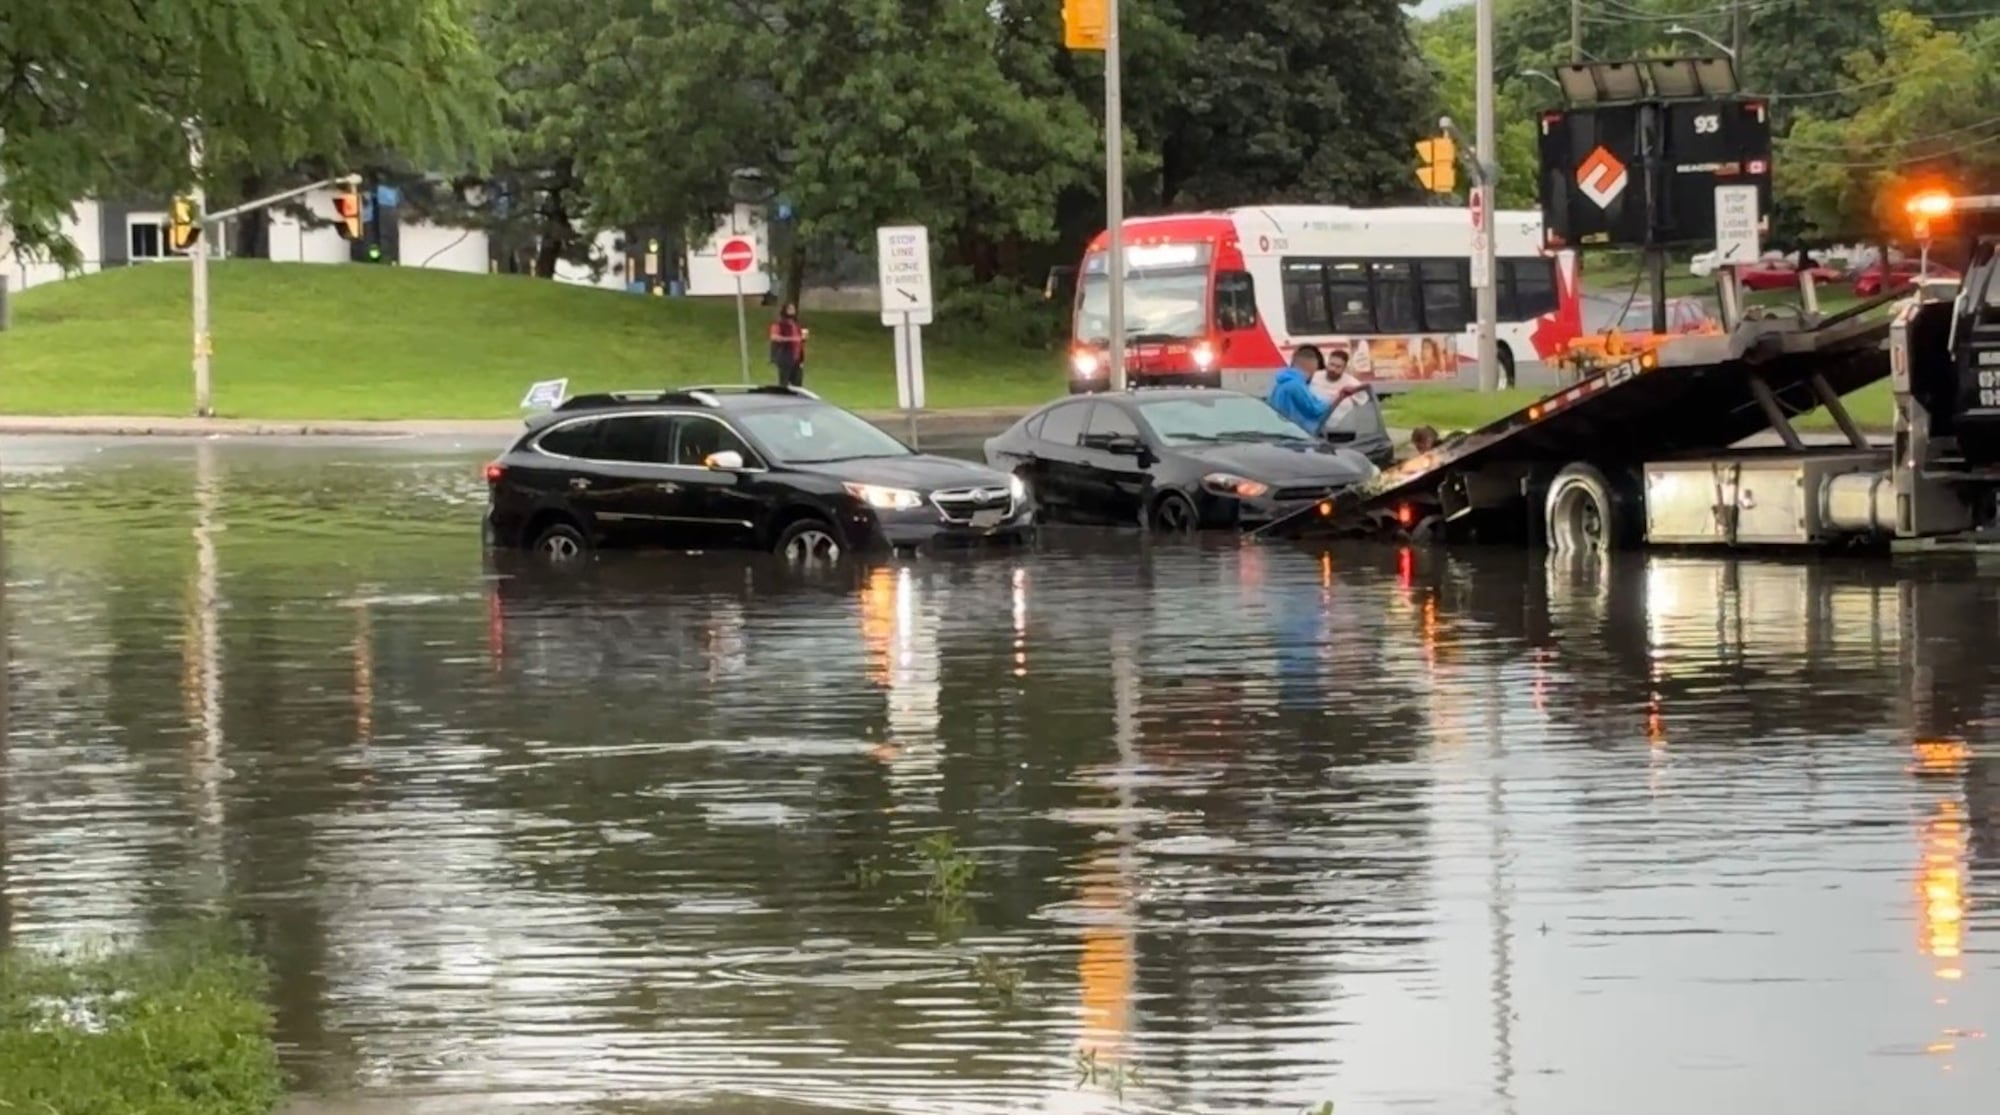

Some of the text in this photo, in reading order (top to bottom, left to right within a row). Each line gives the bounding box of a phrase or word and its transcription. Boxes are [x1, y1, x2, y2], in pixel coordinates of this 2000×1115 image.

[1694, 115, 1719, 133] 93
[1724, 193, 1748, 203] STOP
[1726, 205, 1745, 214] LINE
[889, 235, 916, 245] STOP
[891, 248, 913, 257] LINE
